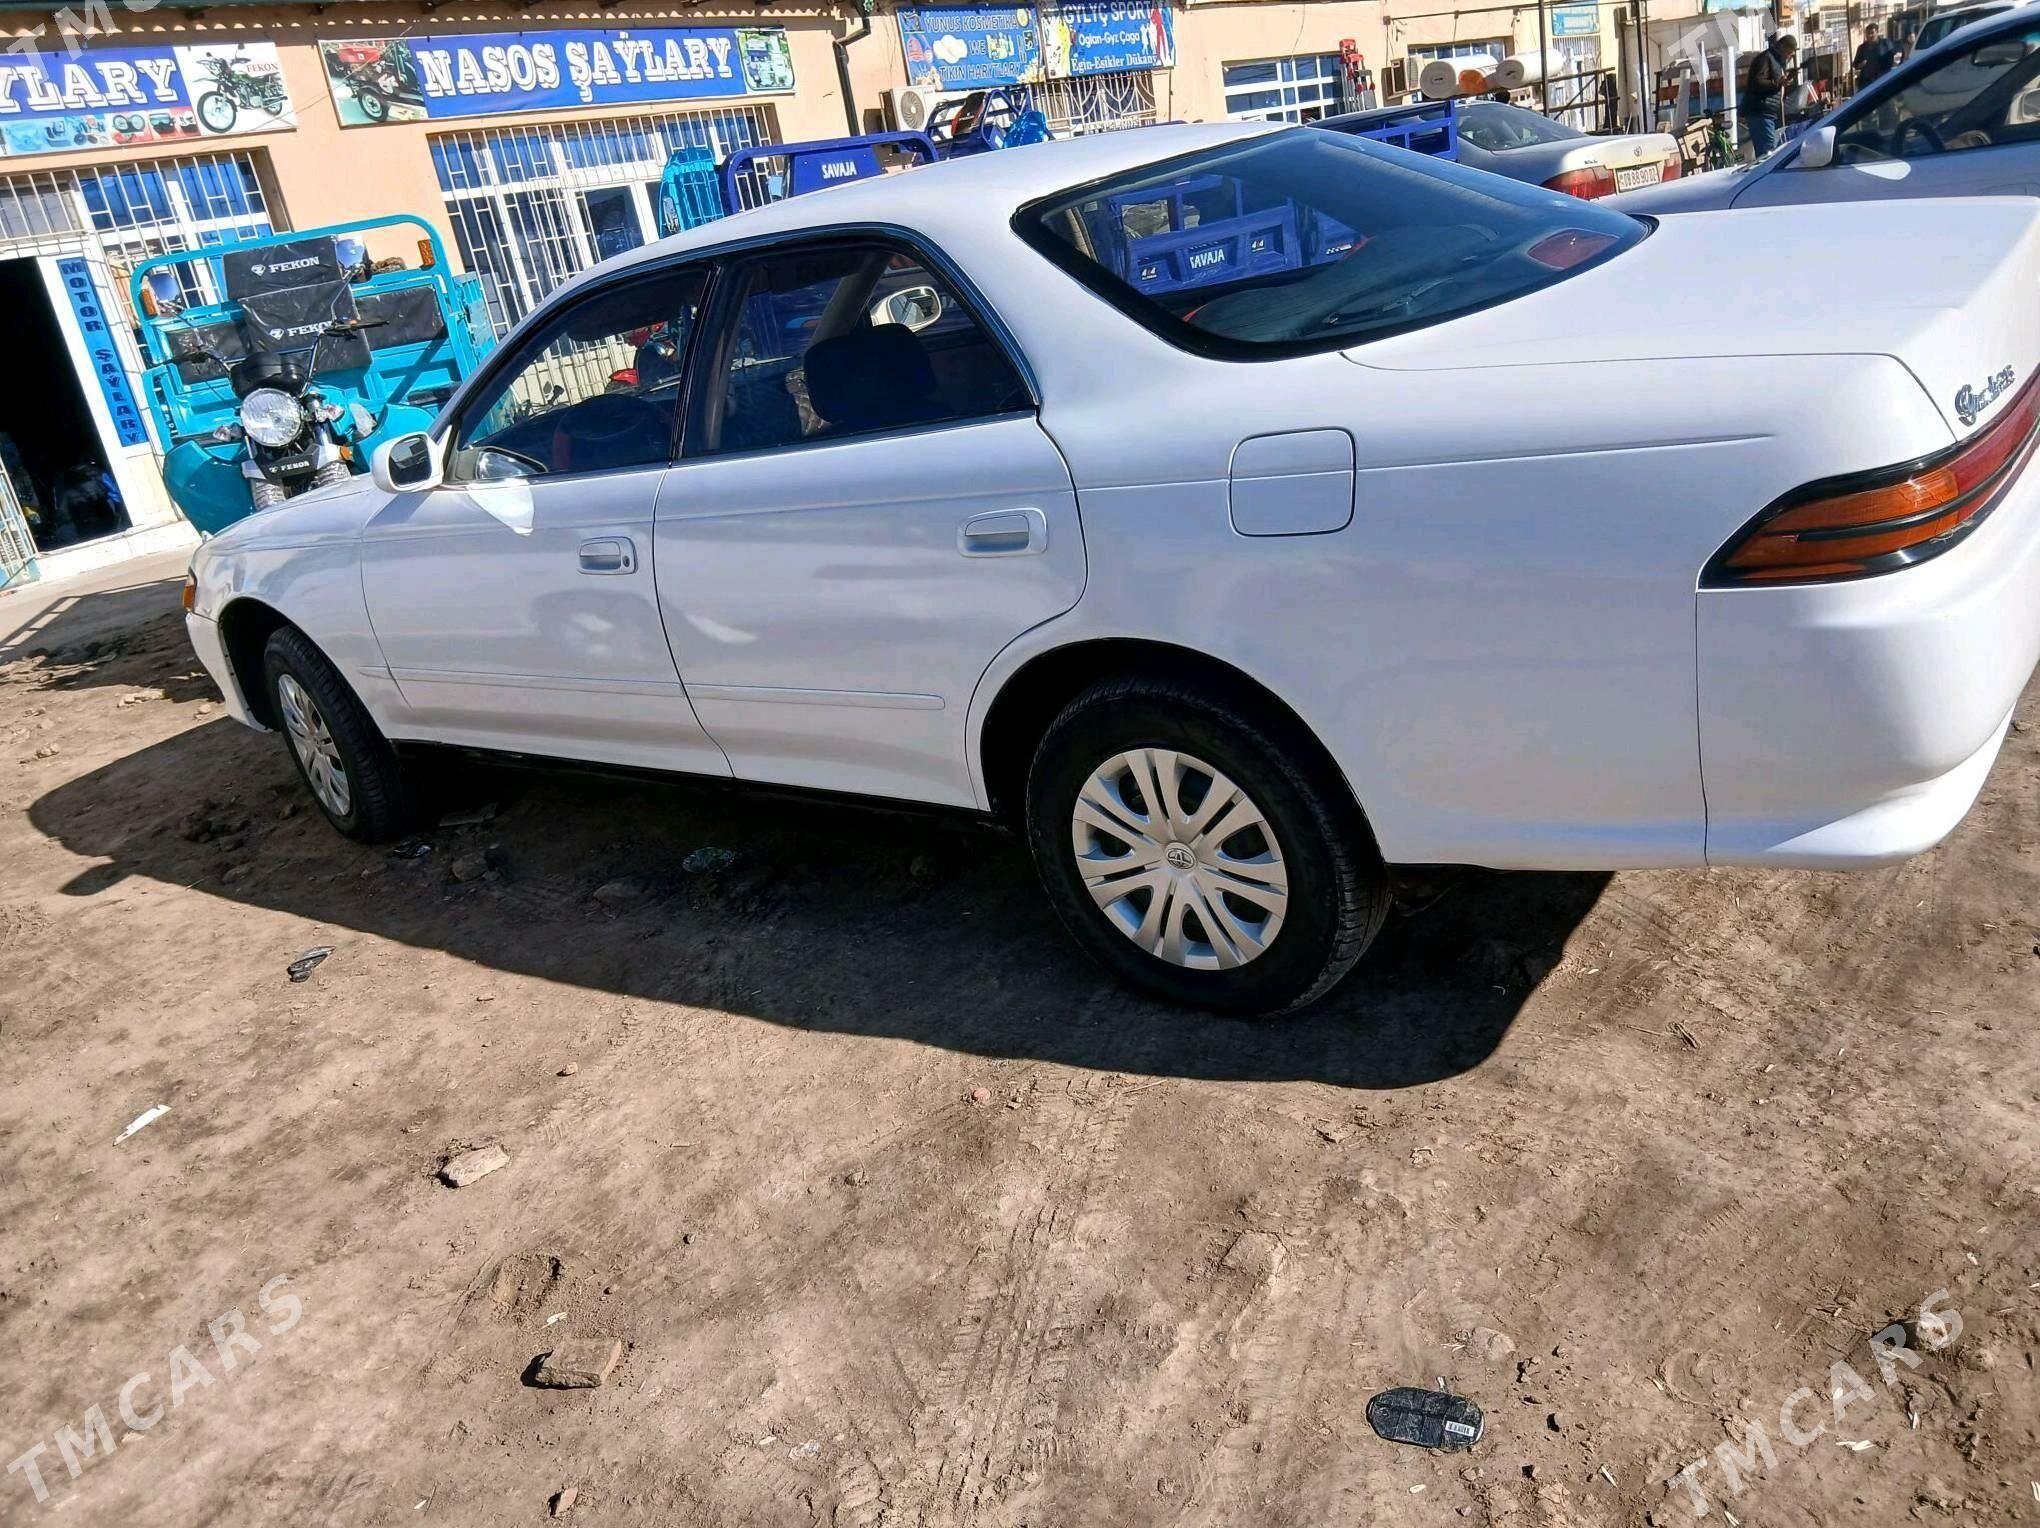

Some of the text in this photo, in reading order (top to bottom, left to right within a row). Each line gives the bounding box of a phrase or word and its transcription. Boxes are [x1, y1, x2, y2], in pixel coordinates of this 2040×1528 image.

[1110, 1, 1151, 21] SPORT
[962, 14, 1018, 31] KOSMETIKA
[968, 39, 986, 55] WE
[417, 32, 732, 102] NASOS ŞAÝLARY
[822, 161, 857, 179] SAVAJA
[268, 256, 320, 273] FEKON
[1190, 249, 1225, 269] SAVAJA
[60, 261, 103, 332] MOTOR
